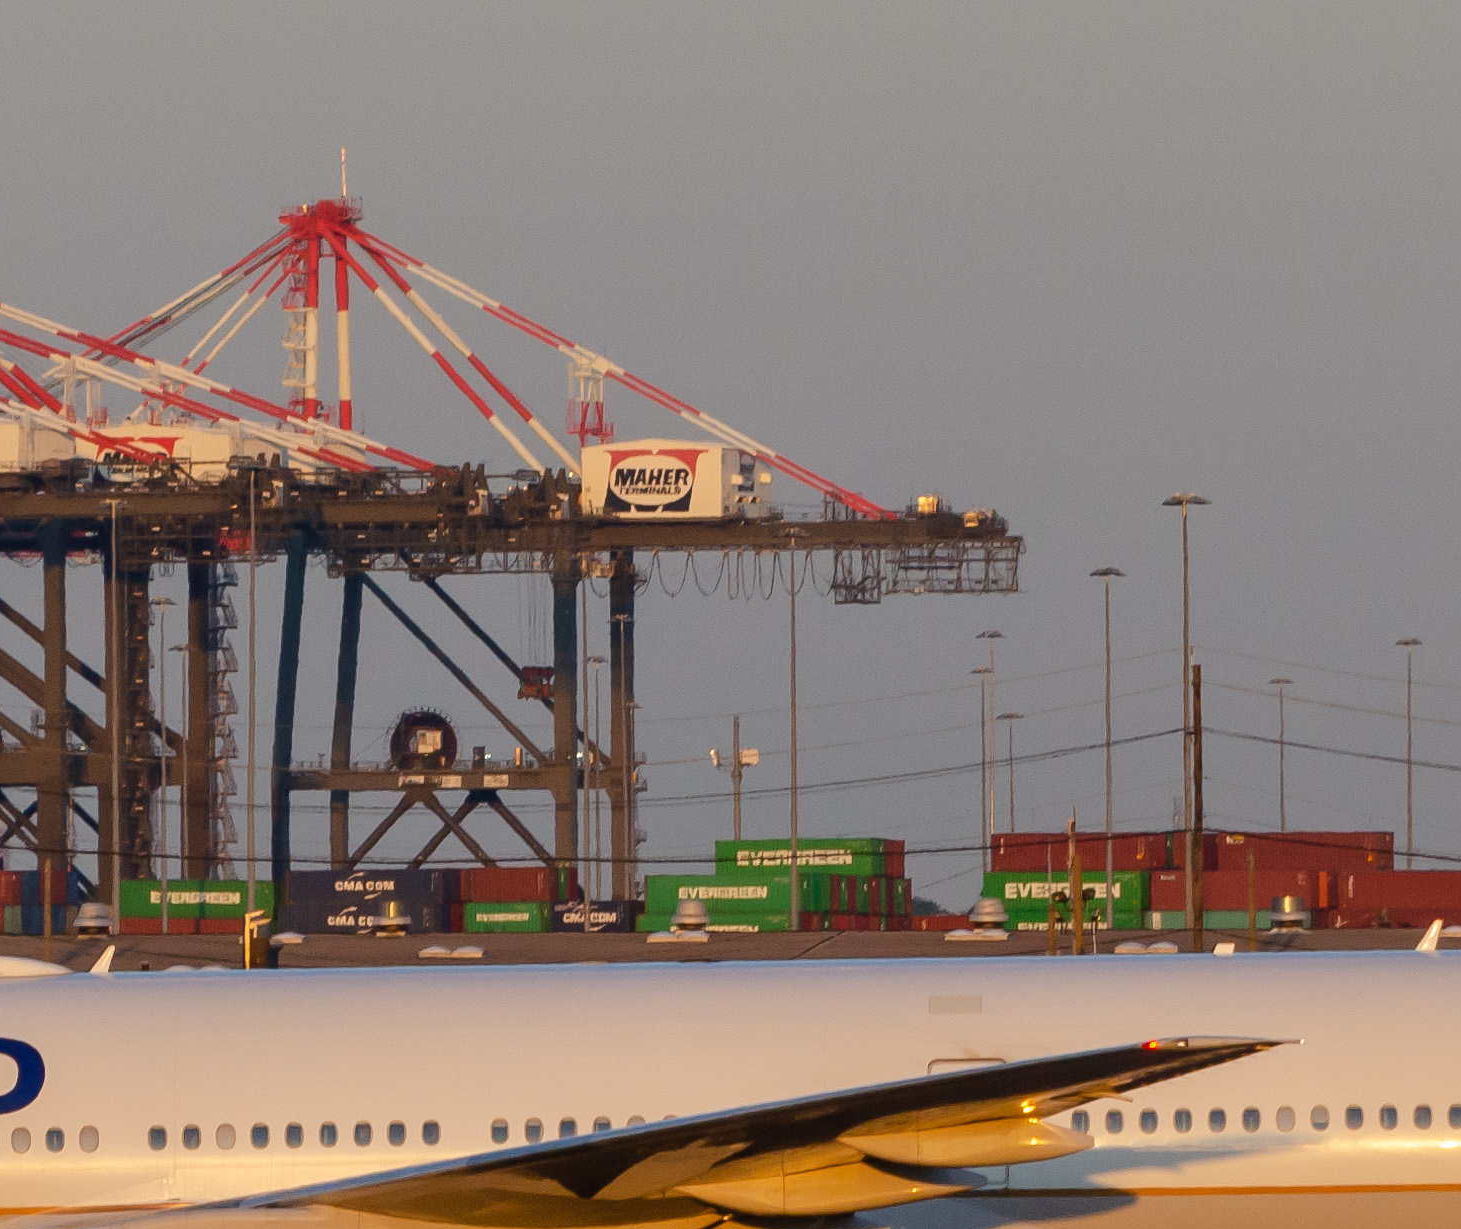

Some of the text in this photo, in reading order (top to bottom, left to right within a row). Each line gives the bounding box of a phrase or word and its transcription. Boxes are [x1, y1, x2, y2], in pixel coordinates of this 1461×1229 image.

[614, 468, 690, 487] MAHER
[619, 485, 682, 496] TERMINALS
[678, 885, 768, 899] EVERGREEN
[1005, 882, 1122, 899] EVERGEN
